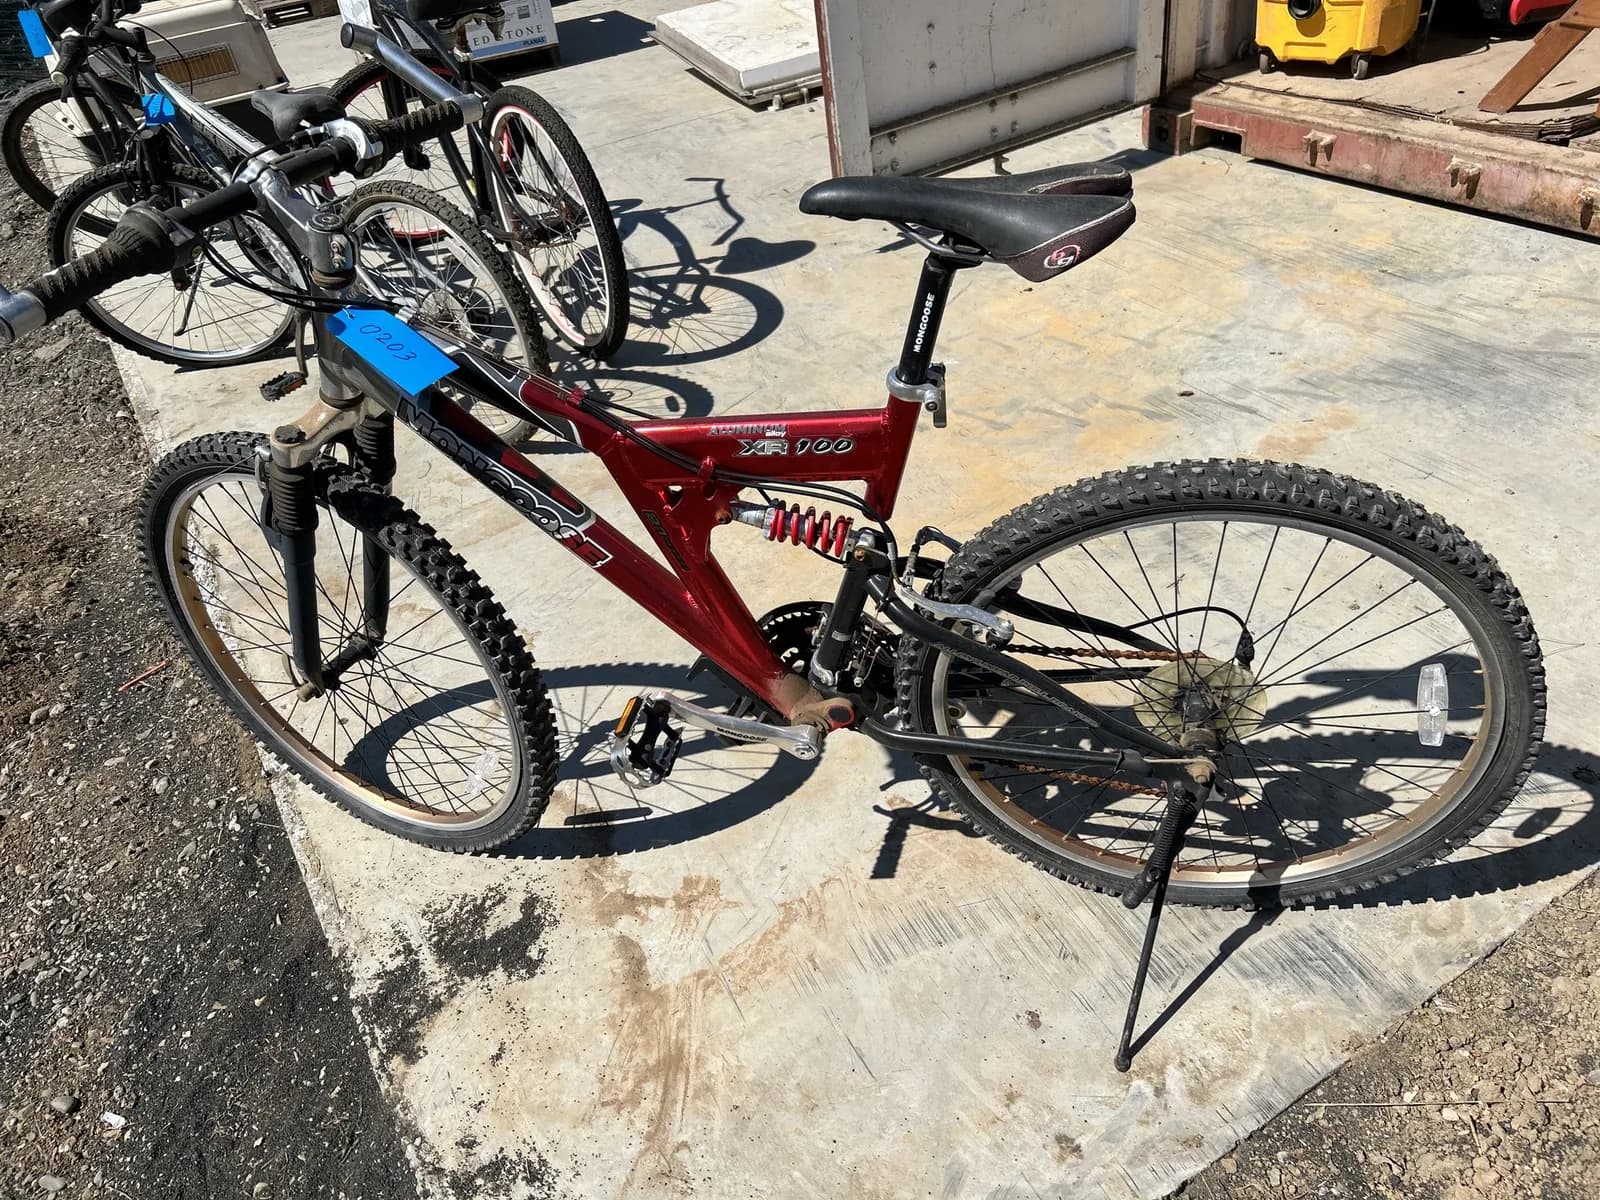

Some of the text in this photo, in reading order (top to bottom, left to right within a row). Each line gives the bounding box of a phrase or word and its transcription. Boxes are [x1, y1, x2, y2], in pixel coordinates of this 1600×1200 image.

[912, 293, 936, 354] MONGOOSE
[359, 324, 417, 361] 0203
[708, 423, 787, 436] ALUMINUM
[765, 430, 787, 438] alloy
[738, 437, 854, 456] XR 100
[404, 399, 613, 569] MONGOOSE
[716, 727, 769, 742] MONGOOSE
